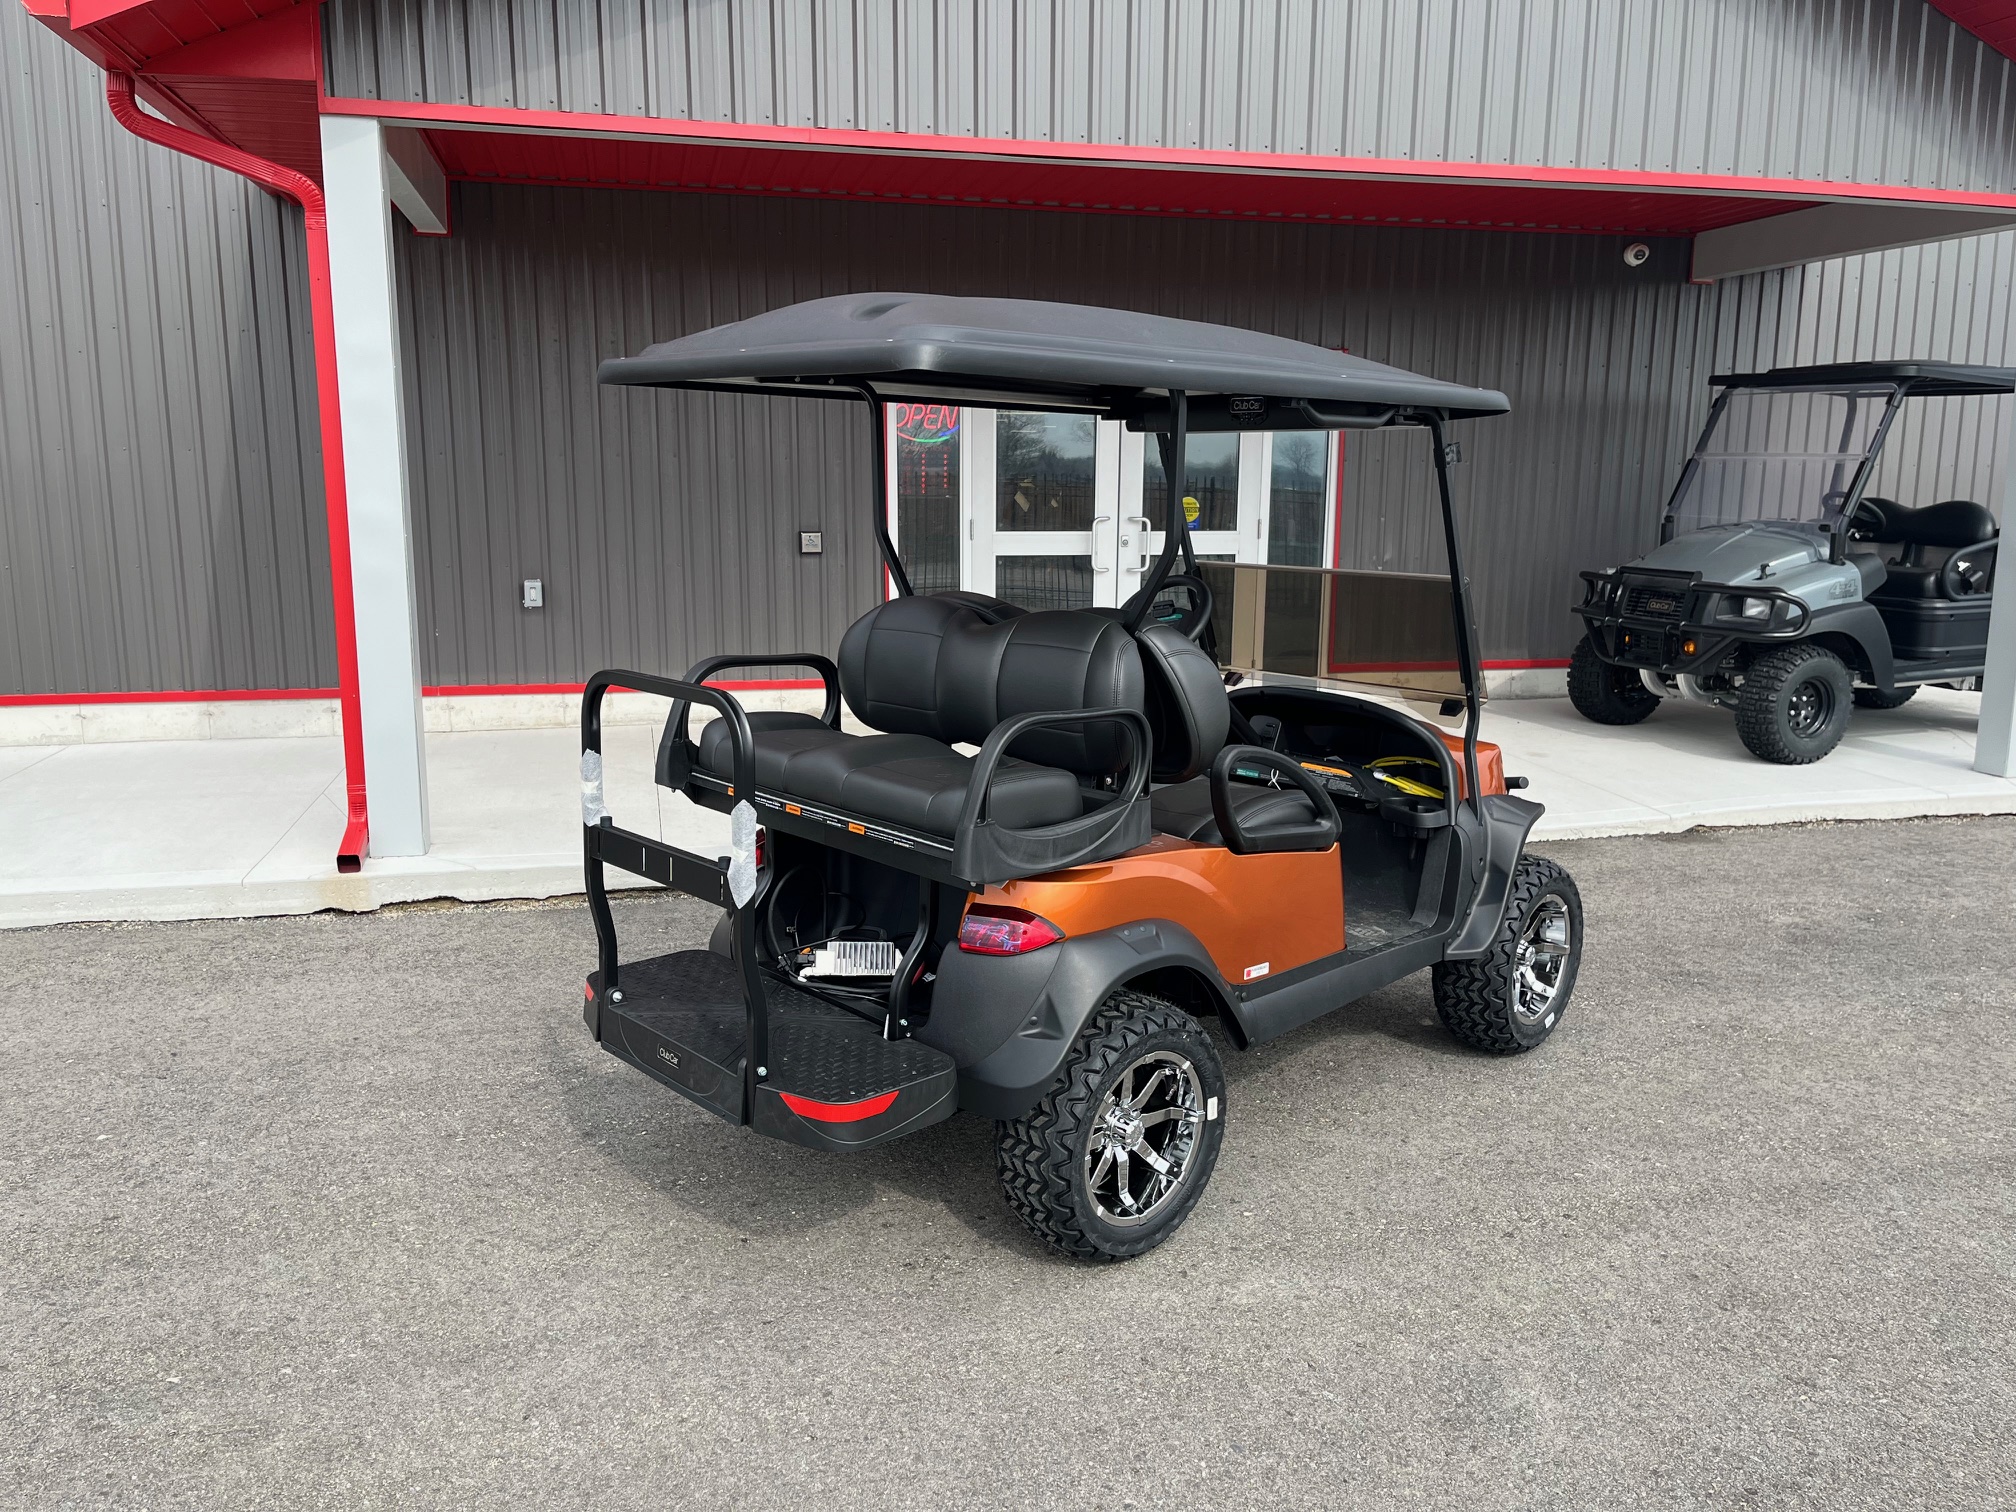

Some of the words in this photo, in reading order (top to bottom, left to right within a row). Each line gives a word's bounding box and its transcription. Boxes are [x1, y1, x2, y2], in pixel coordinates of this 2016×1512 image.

[1233, 401, 1249, 410] Club
[1249, 400, 1261, 410] Car
[896, 403, 959, 429] OPEN
[659, 1047, 670, 1060] Club
[669, 1053, 678, 1064] Car
